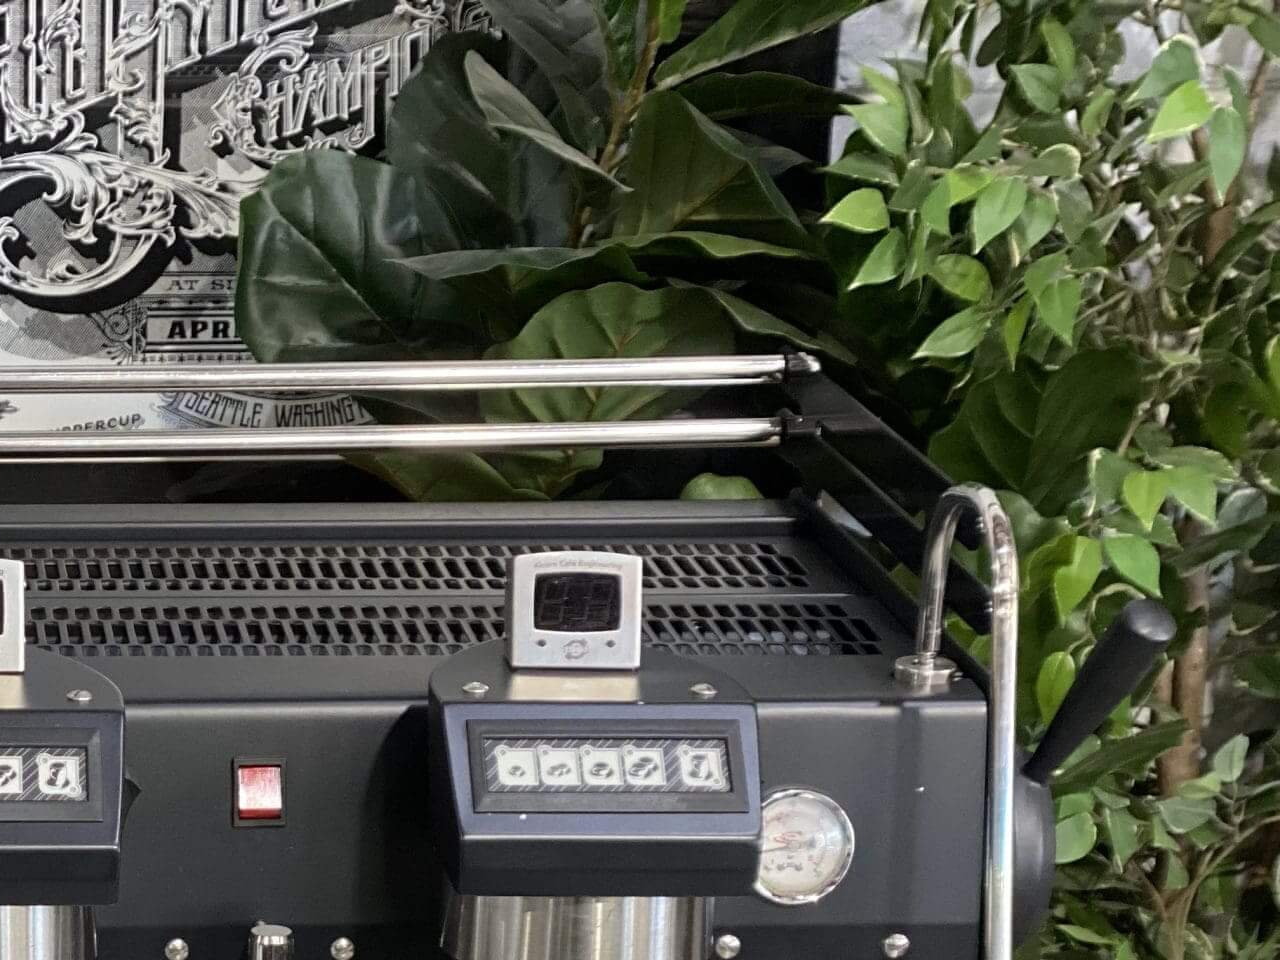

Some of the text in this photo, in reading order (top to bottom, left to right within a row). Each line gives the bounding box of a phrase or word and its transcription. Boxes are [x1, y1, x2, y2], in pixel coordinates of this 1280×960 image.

[166, 280, 199, 290] AT
[168, 320, 239, 339] APR
[184, 391, 263, 428] SEATTLE
